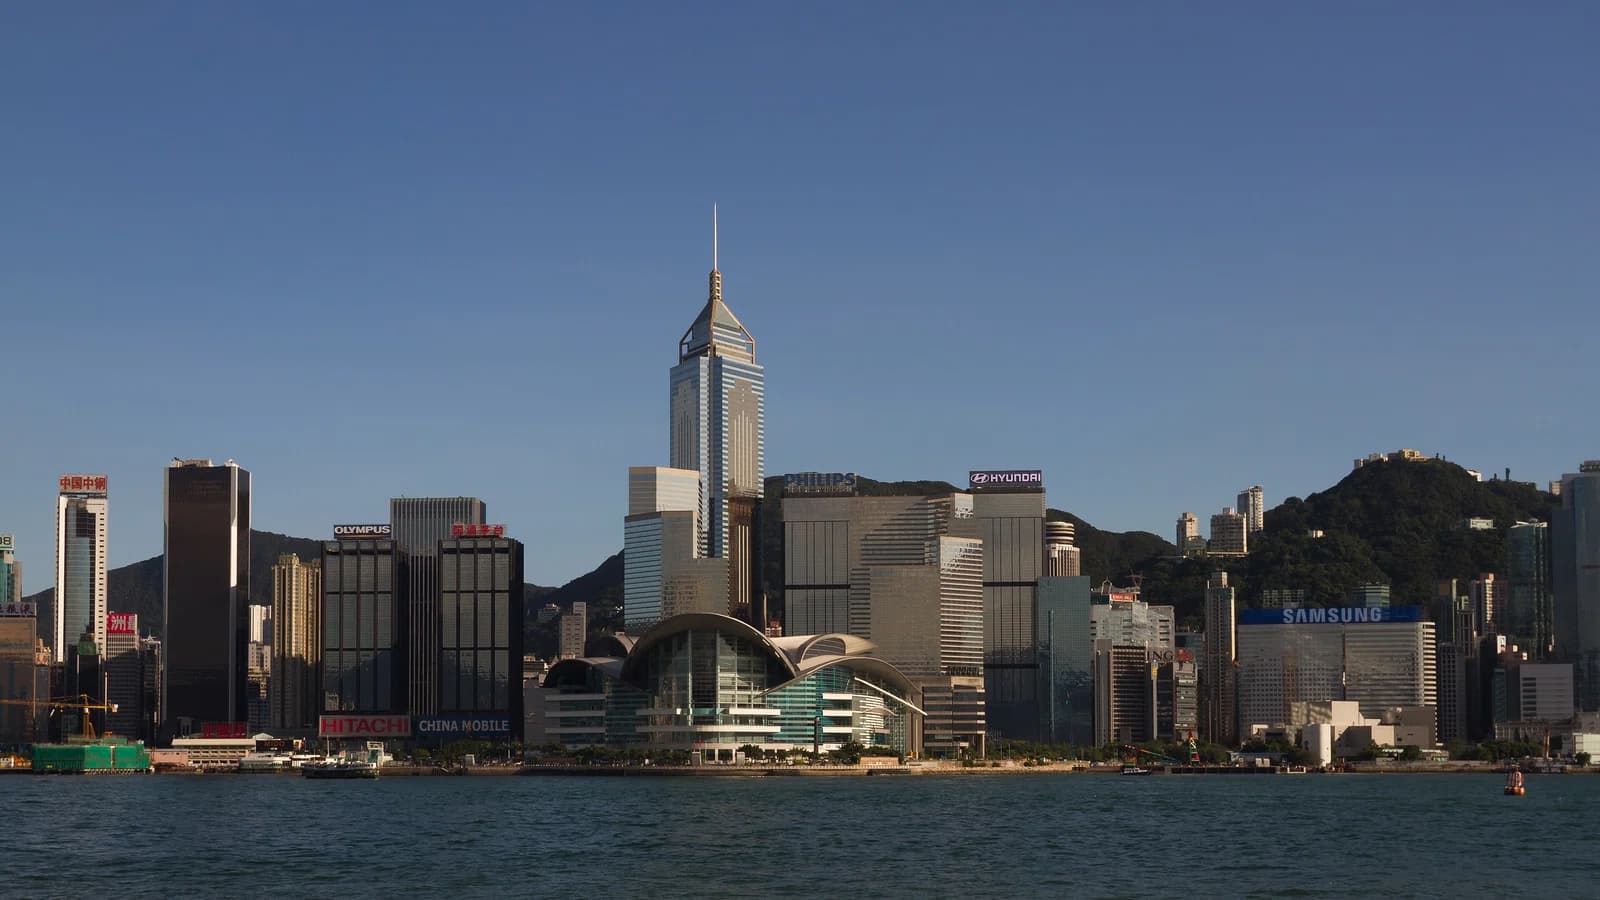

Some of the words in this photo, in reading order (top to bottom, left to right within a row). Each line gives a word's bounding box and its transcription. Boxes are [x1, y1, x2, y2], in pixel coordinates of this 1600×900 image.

[784, 472, 855, 486] PHILIPS
[990, 474, 1040, 482] HYUNDAI
[334, 526, 390, 534] OLYMPUS
[1282, 608, 1381, 623] SAMSUNG
[1147, 651, 1173, 660] ING
[322, 719, 409, 733] HITACHI
[419, 720, 458, 731] CHINA
[462, 720, 510, 731] MOBILE
